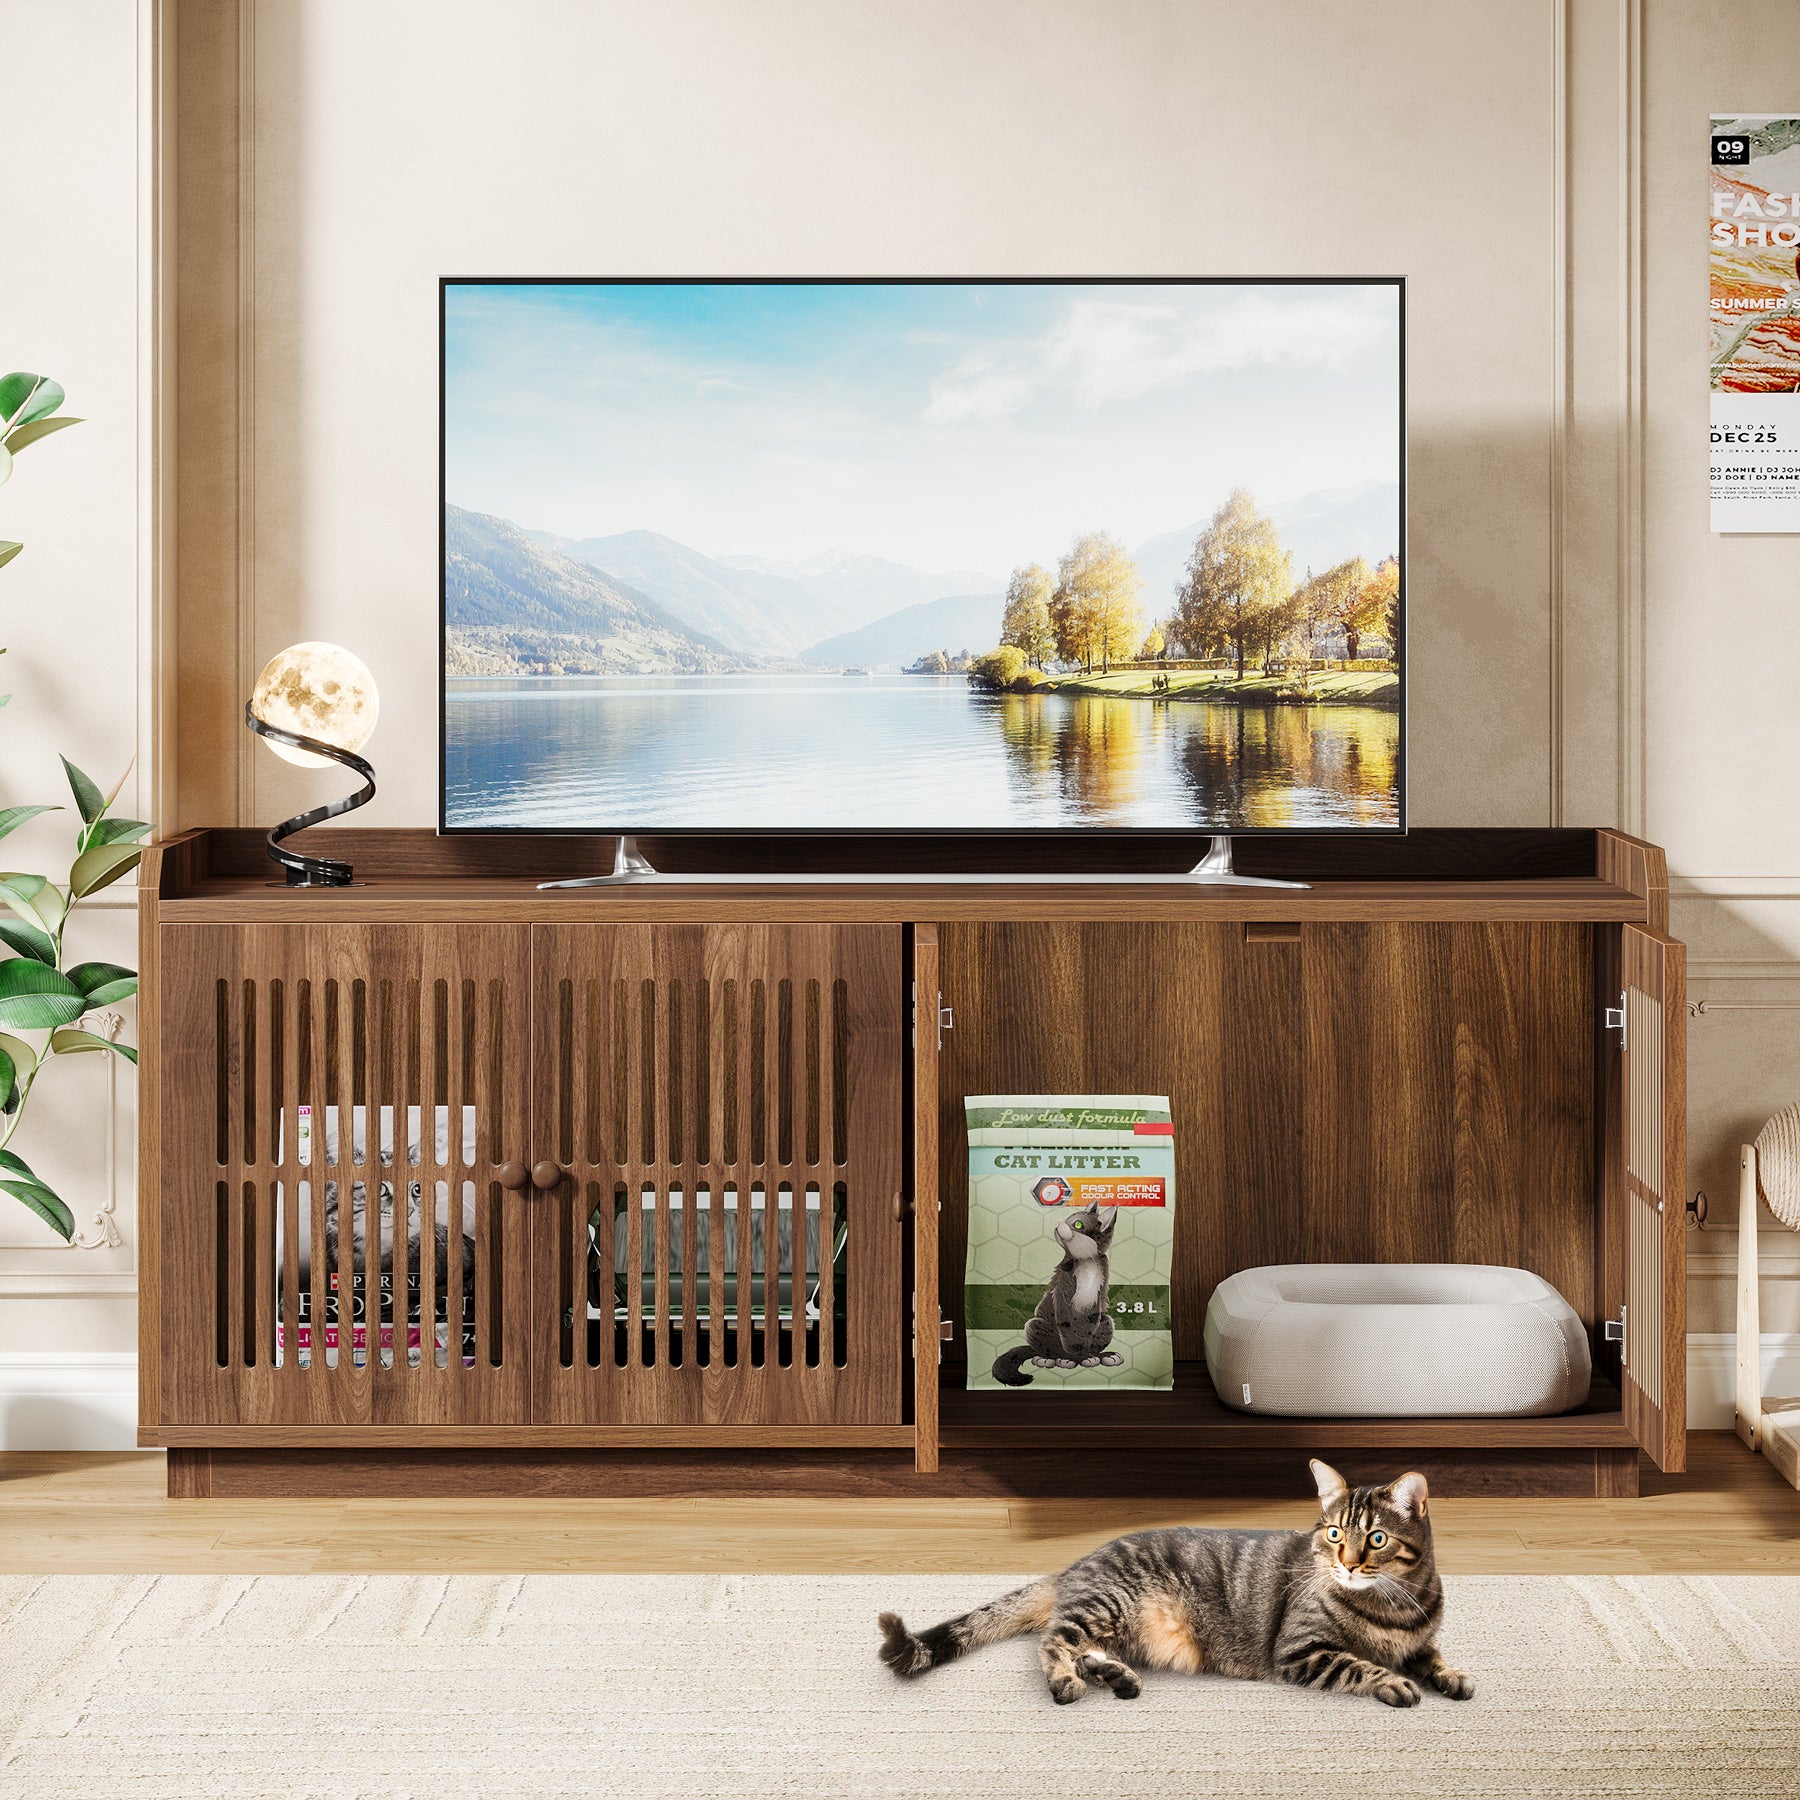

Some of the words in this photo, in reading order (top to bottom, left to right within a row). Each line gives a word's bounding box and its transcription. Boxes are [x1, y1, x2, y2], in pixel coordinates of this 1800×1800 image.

[1717, 141, 1744, 153] 09
[1711, 222, 1800, 247] SHO
[1710, 298, 1788, 309] SUMMER
[1710, 432, 1750, 443] DEC
[1754, 432, 1777, 443] 25
[992, 1109, 1033, 1127] Low
[1038, 1109, 1073, 1122] dust
[1076, 1110, 1146, 1128] formula
[994, 1155, 1041, 1168] CAT
[1048, 1155, 1141, 1169] LITTER
[1080, 1184, 1113, 1192] FAST
[1117, 1184, 1160, 1192] ACTING
[1116, 1301, 1144, 1313] 3.8
[1148, 1301, 1157, 1313] L
